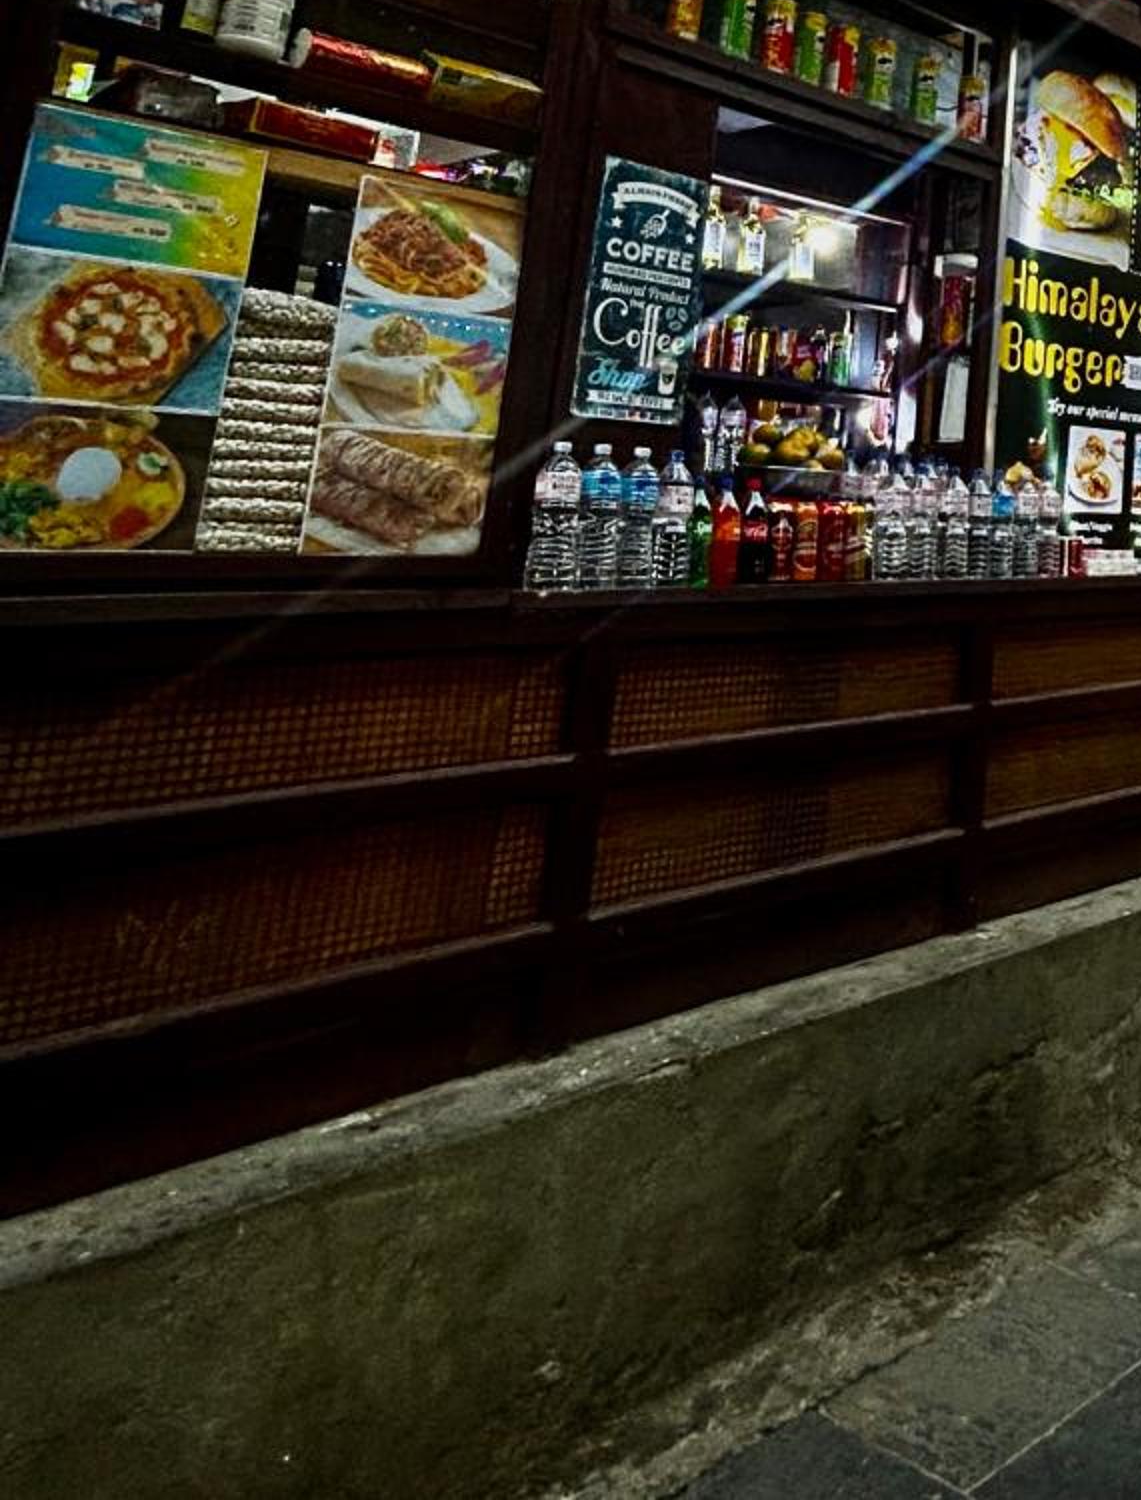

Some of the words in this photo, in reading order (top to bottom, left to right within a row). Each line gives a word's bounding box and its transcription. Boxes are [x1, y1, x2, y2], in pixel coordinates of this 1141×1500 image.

[606, 237, 695, 273] COFFEE
[600, 276, 647, 297] Natural
[593, 297, 686, 368] Coffee
[998, 320, 1122, 393] Burger
[1066, 405, 1085, 416] our
[1085, 406, 1119, 421] special
